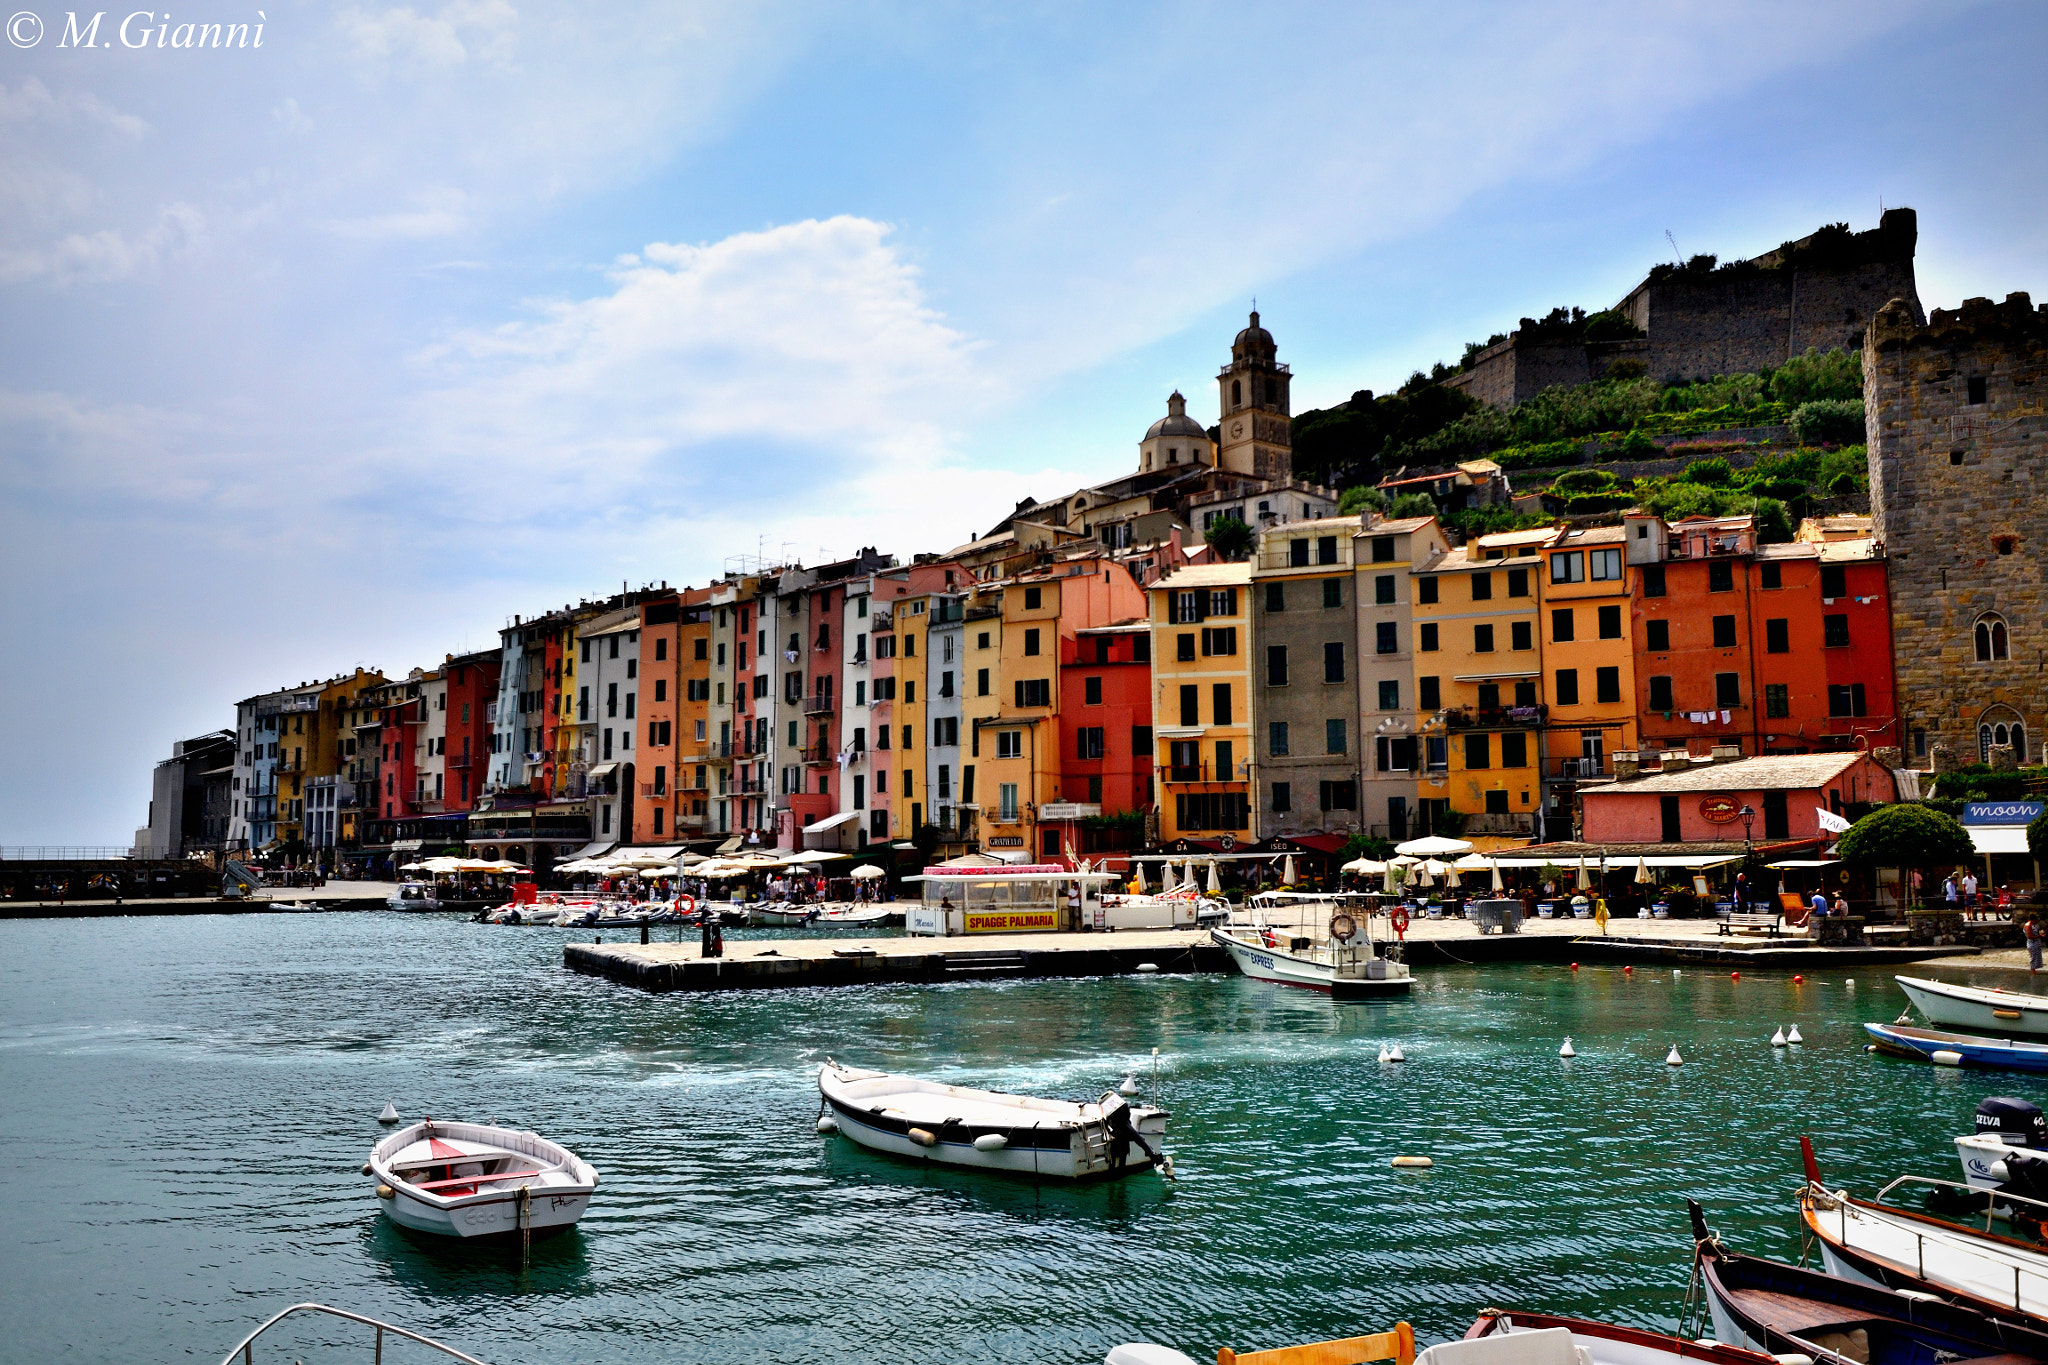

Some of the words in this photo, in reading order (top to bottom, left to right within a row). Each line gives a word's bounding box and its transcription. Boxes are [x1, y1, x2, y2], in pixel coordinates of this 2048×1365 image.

[1714, 811, 1737, 821] MARINA
[1971, 805, 2039, 816] moon
[969, 916, 1007, 929] SPIAGGE
[1010, 915, 1054, 927] PALMARIA
[1250, 952, 1275, 970] EXPRESS
[1976, 1114, 2000, 1127] SELVA
